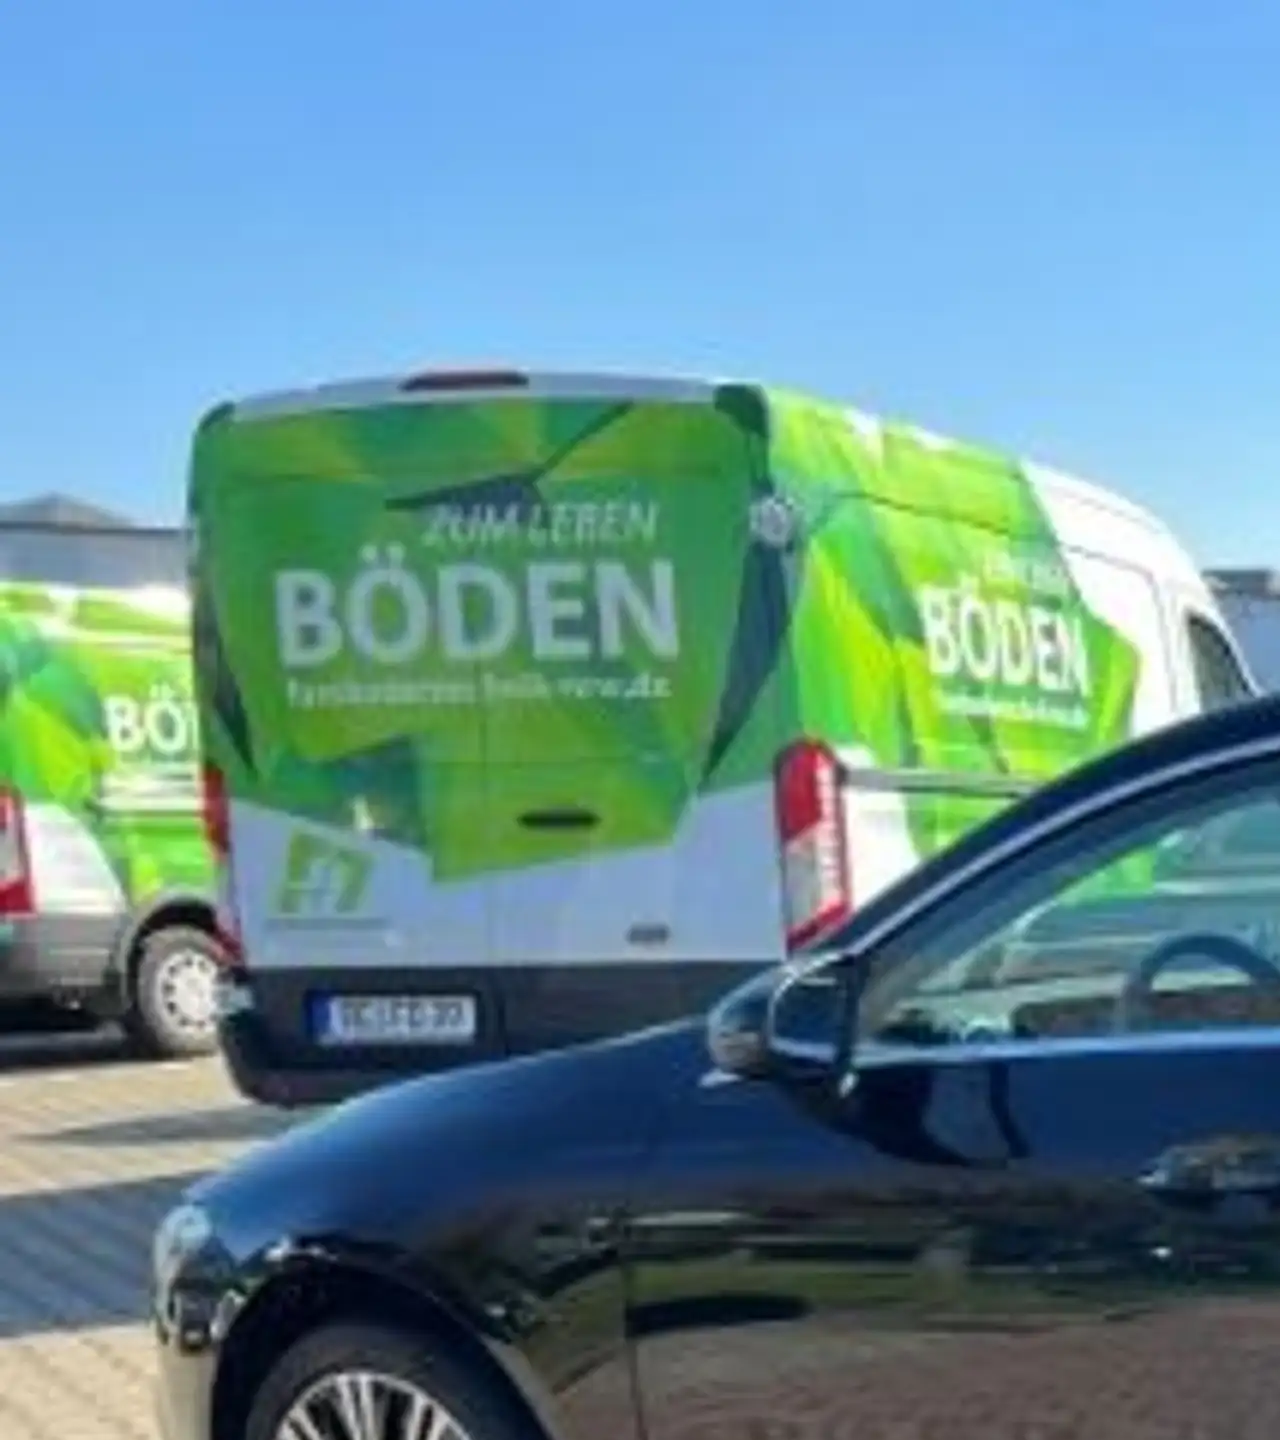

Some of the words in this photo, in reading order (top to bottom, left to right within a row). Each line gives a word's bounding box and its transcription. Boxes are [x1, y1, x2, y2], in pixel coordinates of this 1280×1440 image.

[528, 501, 661, 546] LEBEN
[273, 543, 680, 668] BÖDEN
[916, 571, 1091, 698] BÖDEN
